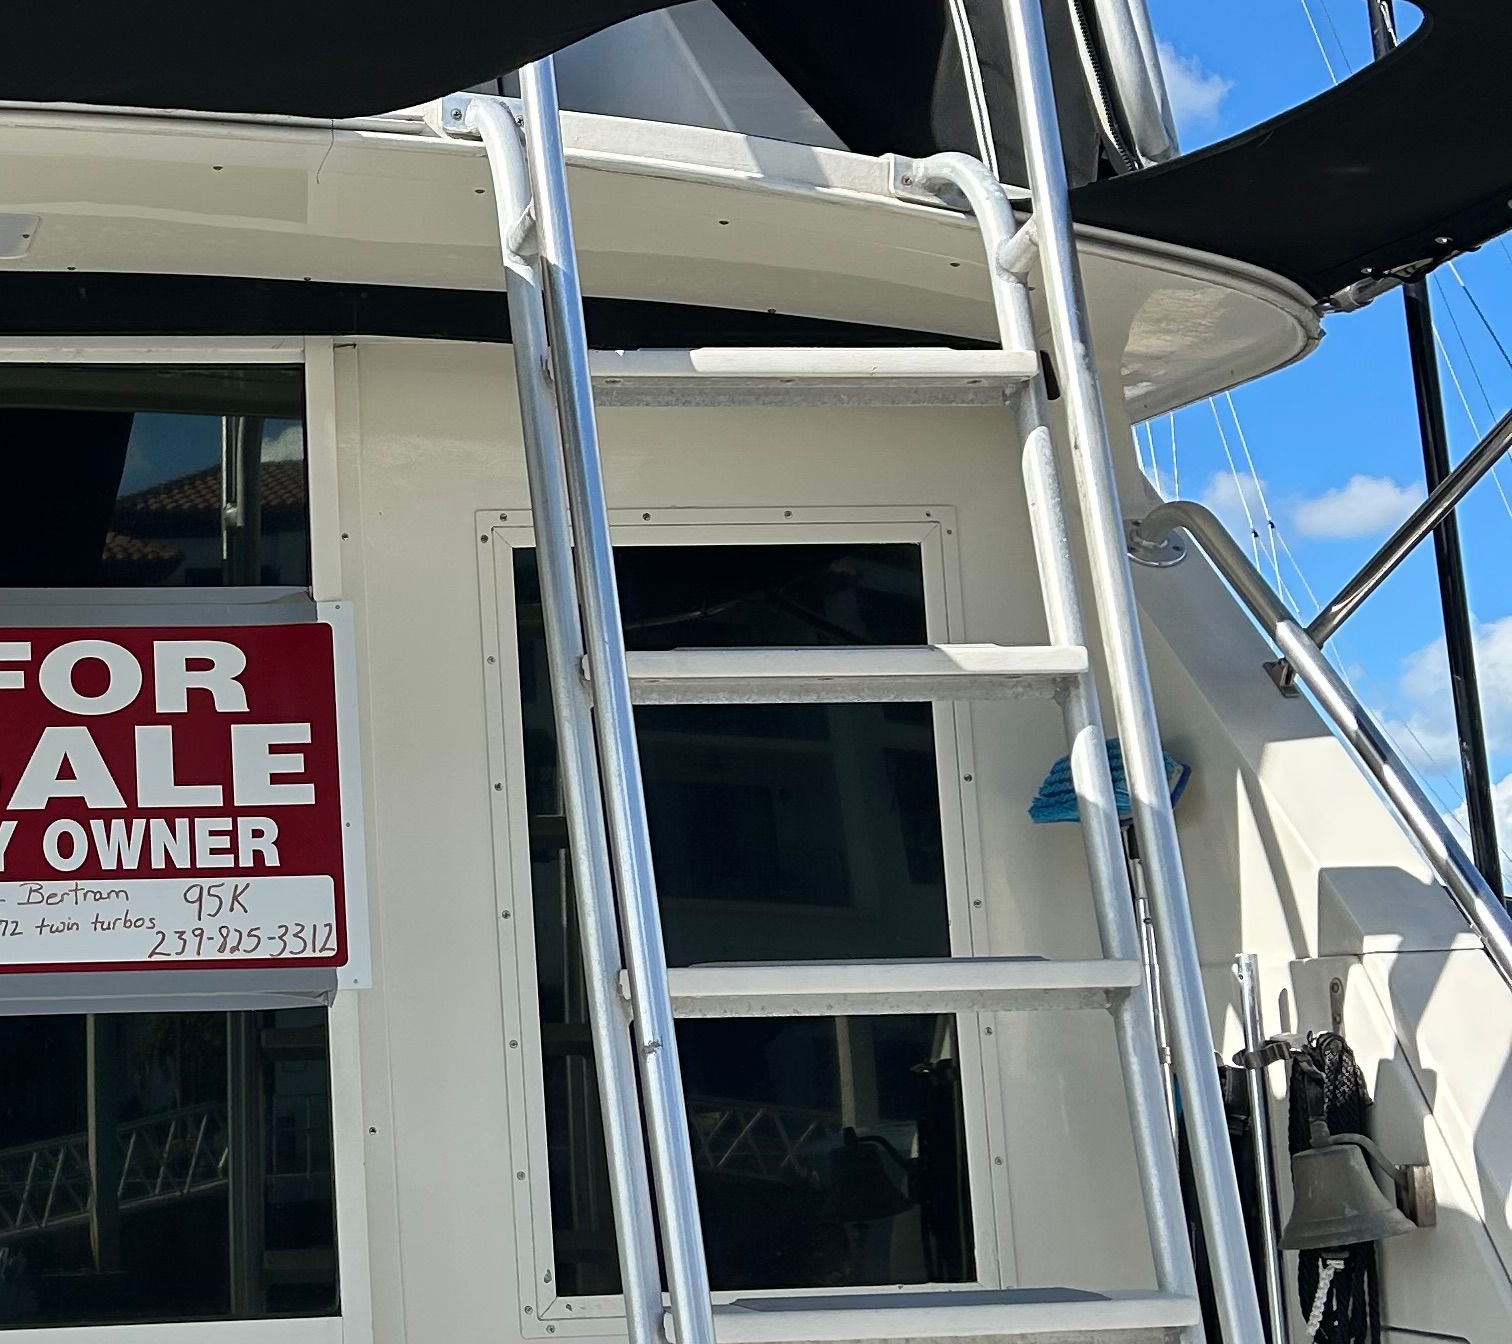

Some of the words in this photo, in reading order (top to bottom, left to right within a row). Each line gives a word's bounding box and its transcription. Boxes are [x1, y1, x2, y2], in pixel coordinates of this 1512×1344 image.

[43, 817, 280, 871] OWNER
[17, 882, 129, 906] Bertram
[183, 882, 251, 921] 95K
[35, 917, 80, 935] twin
[91, 909, 156, 931] turbos
[147, 922, 336, 959] 239-825-3312
